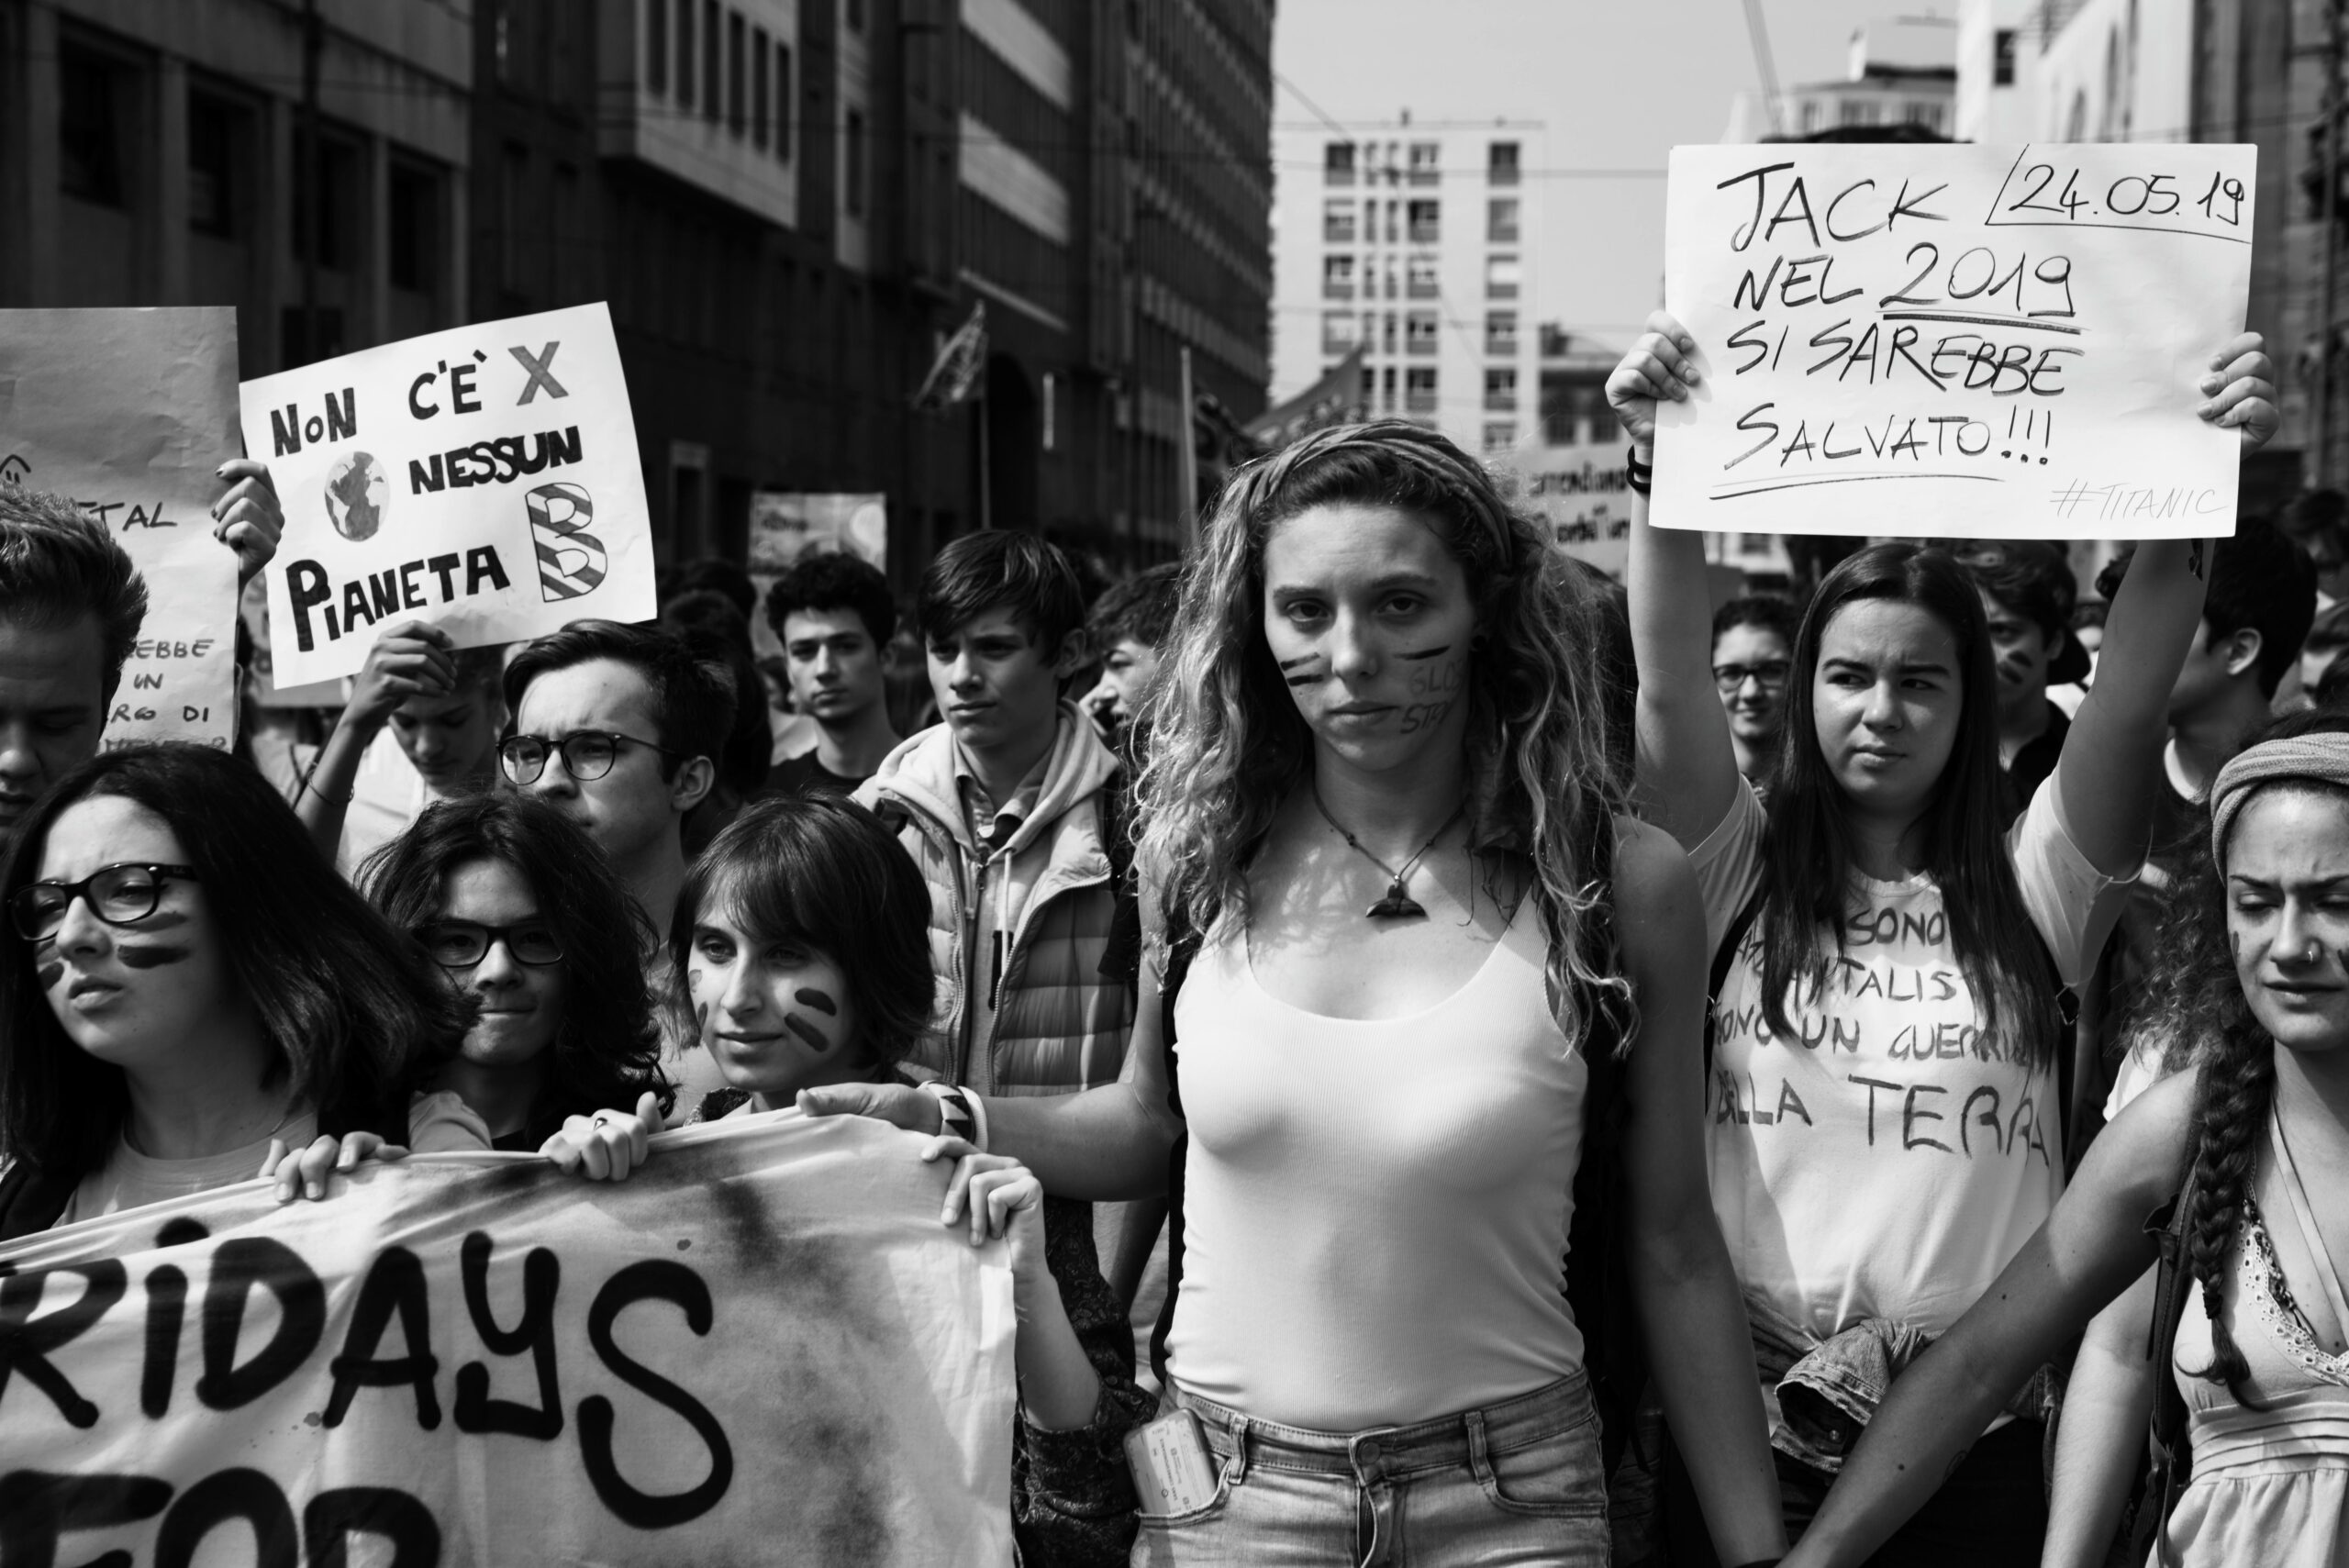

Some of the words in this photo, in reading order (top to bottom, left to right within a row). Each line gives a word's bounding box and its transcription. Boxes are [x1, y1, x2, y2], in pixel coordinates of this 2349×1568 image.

[1717, 161, 1949, 252] JACK
[1733, 254, 1864, 311] NEL
[1879, 242, 2076, 317] 2019
[1727, 319, 1789, 374] SI
[1807, 318, 2084, 397] SAREBBE
[408, 426, 583, 495] NESSUN
[1724, 402, 2051, 470] SALVATO!!!
[2049, 478, 2228, 520] #TITANIC
[525, 483, 607, 602] B
[128, 639, 215, 659] EBBE
[184, 705, 208, 722] DI
[1845, 906, 1945, 951] SONO
[1801, 1015, 1861, 1054] UN
